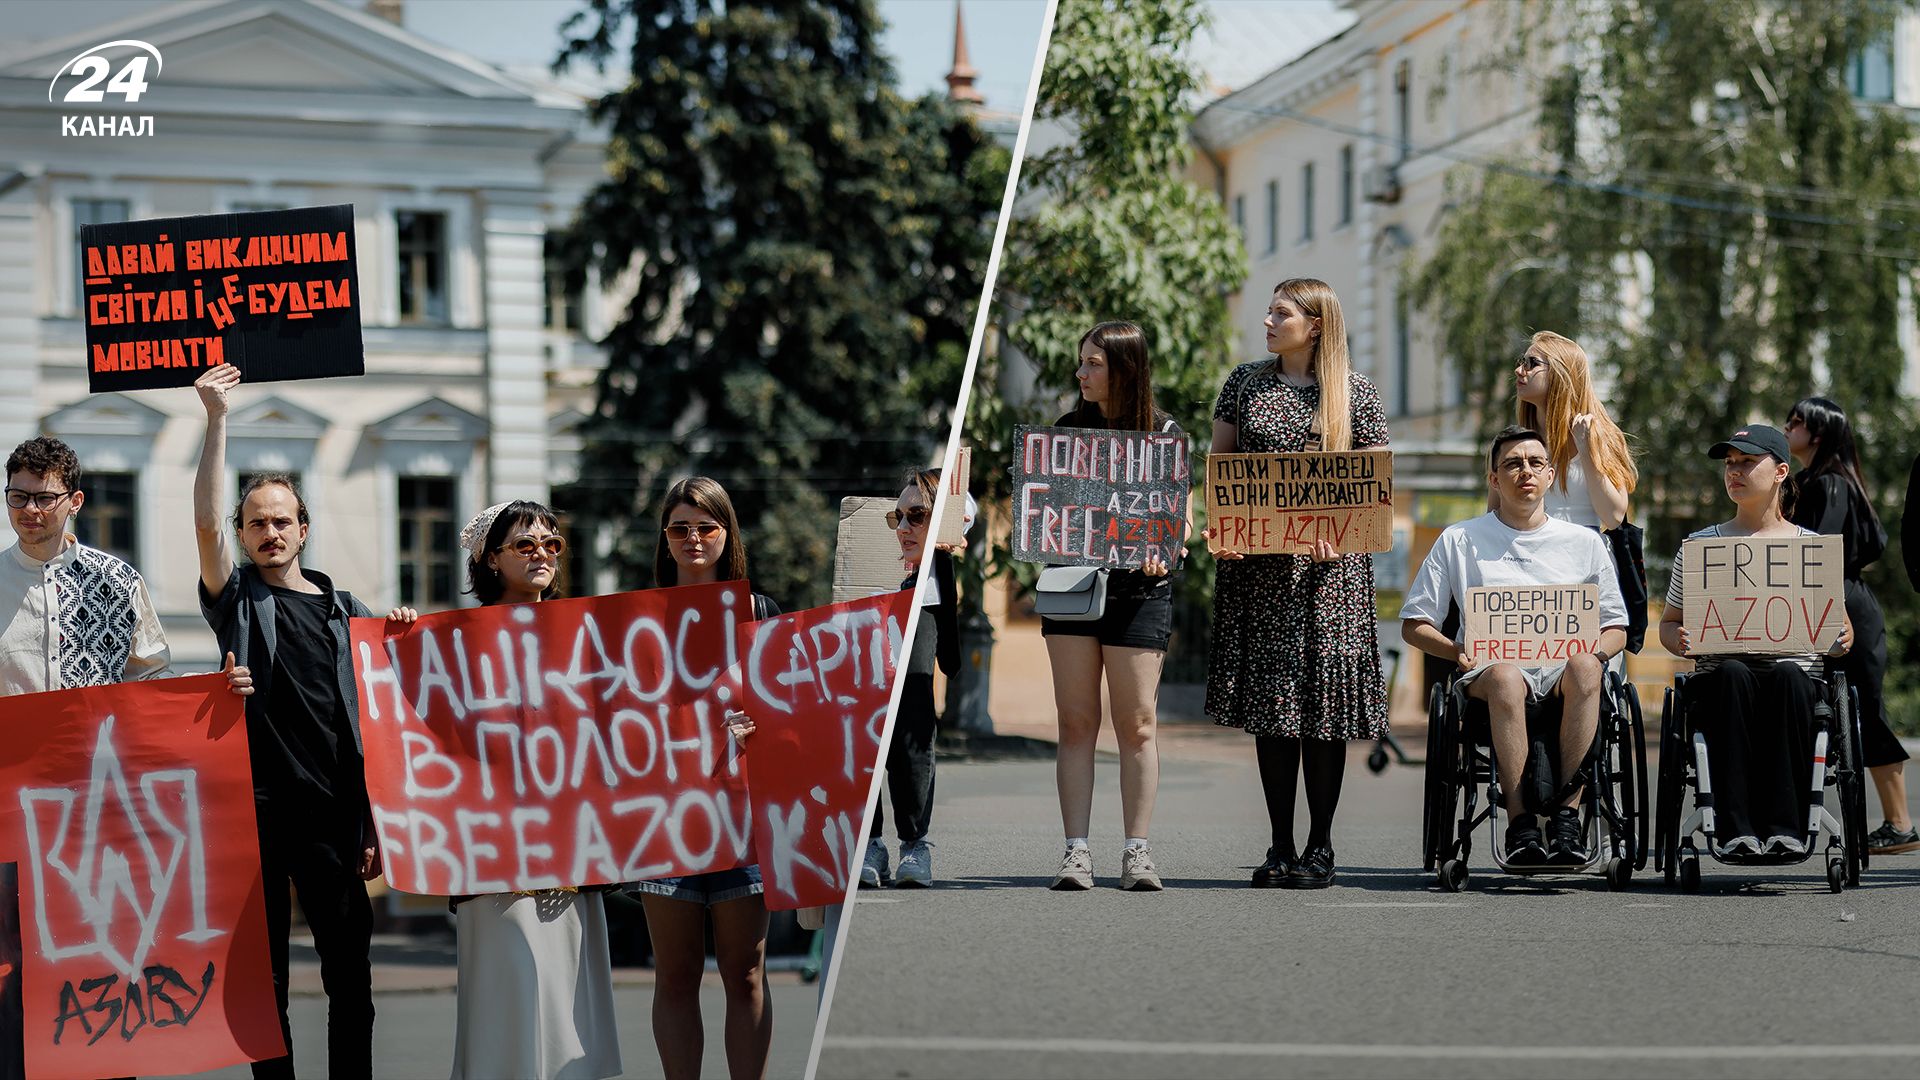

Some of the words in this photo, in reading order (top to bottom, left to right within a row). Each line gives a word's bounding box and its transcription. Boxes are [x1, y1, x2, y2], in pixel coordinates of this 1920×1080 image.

[86, 234, 176, 285] ДАВАЙ
[186, 232, 348, 271] ВИКЛЮЧИМ
[206, 274, 244, 330] НЕ
[248, 279, 351, 320] БУДЕМ
[93, 336, 225, 373] МОВЧАТИ
[1217, 459, 1269, 480] ПОКИ
[1275, 458, 1301, 480] ТИ
[1306, 456, 1375, 480] ЖИВЕШ
[1107, 490, 1180, 515] AZOV
[1215, 483, 1269, 506] ВОНИ
[1020, 482, 1105, 560] FREE
[1106, 517, 1182, 543] AZOV
[1219, 515, 1271, 549] FREE
[1282, 511, 1353, 549] AZOV
[1703, 543, 1824, 589] FREE
[1473, 590, 1594, 612] ПОВЕРНІТЬ
[1489, 612, 1581, 635] ГЕРОЇВ
[1700, 596, 1834, 646] AZOV
[402, 730, 463, 799] В
[54, 960, 215, 1047] АЗОВУ
